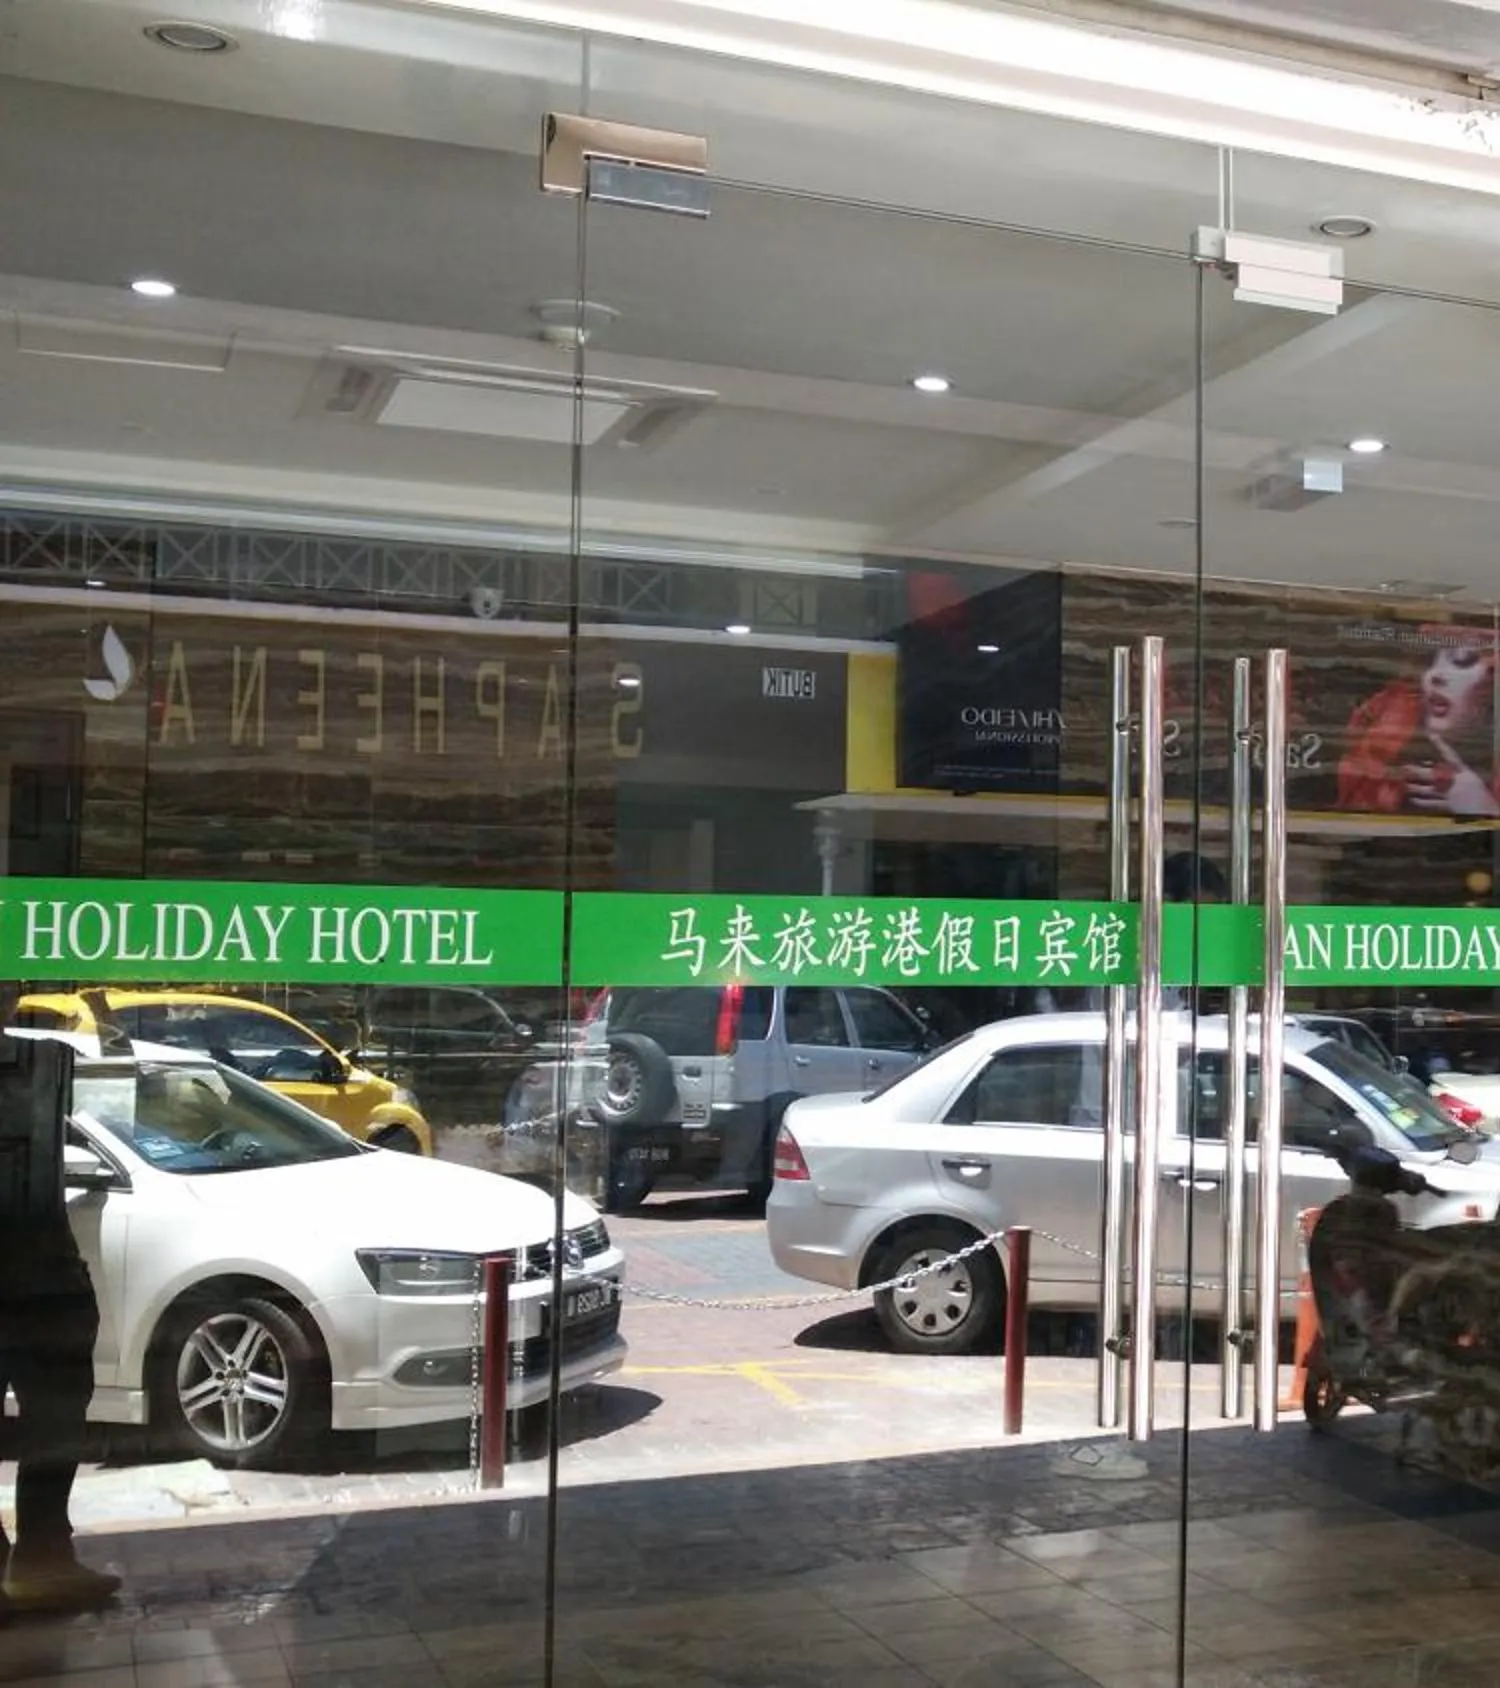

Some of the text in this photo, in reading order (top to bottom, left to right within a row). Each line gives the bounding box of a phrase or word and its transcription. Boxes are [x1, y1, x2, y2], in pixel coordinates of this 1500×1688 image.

[21, 901, 493, 966] HOLIDAY HOTEL
[660, 904, 1127, 978] 马来旅游港假日宾馆
[1257, 922, 1335, 971] AN
